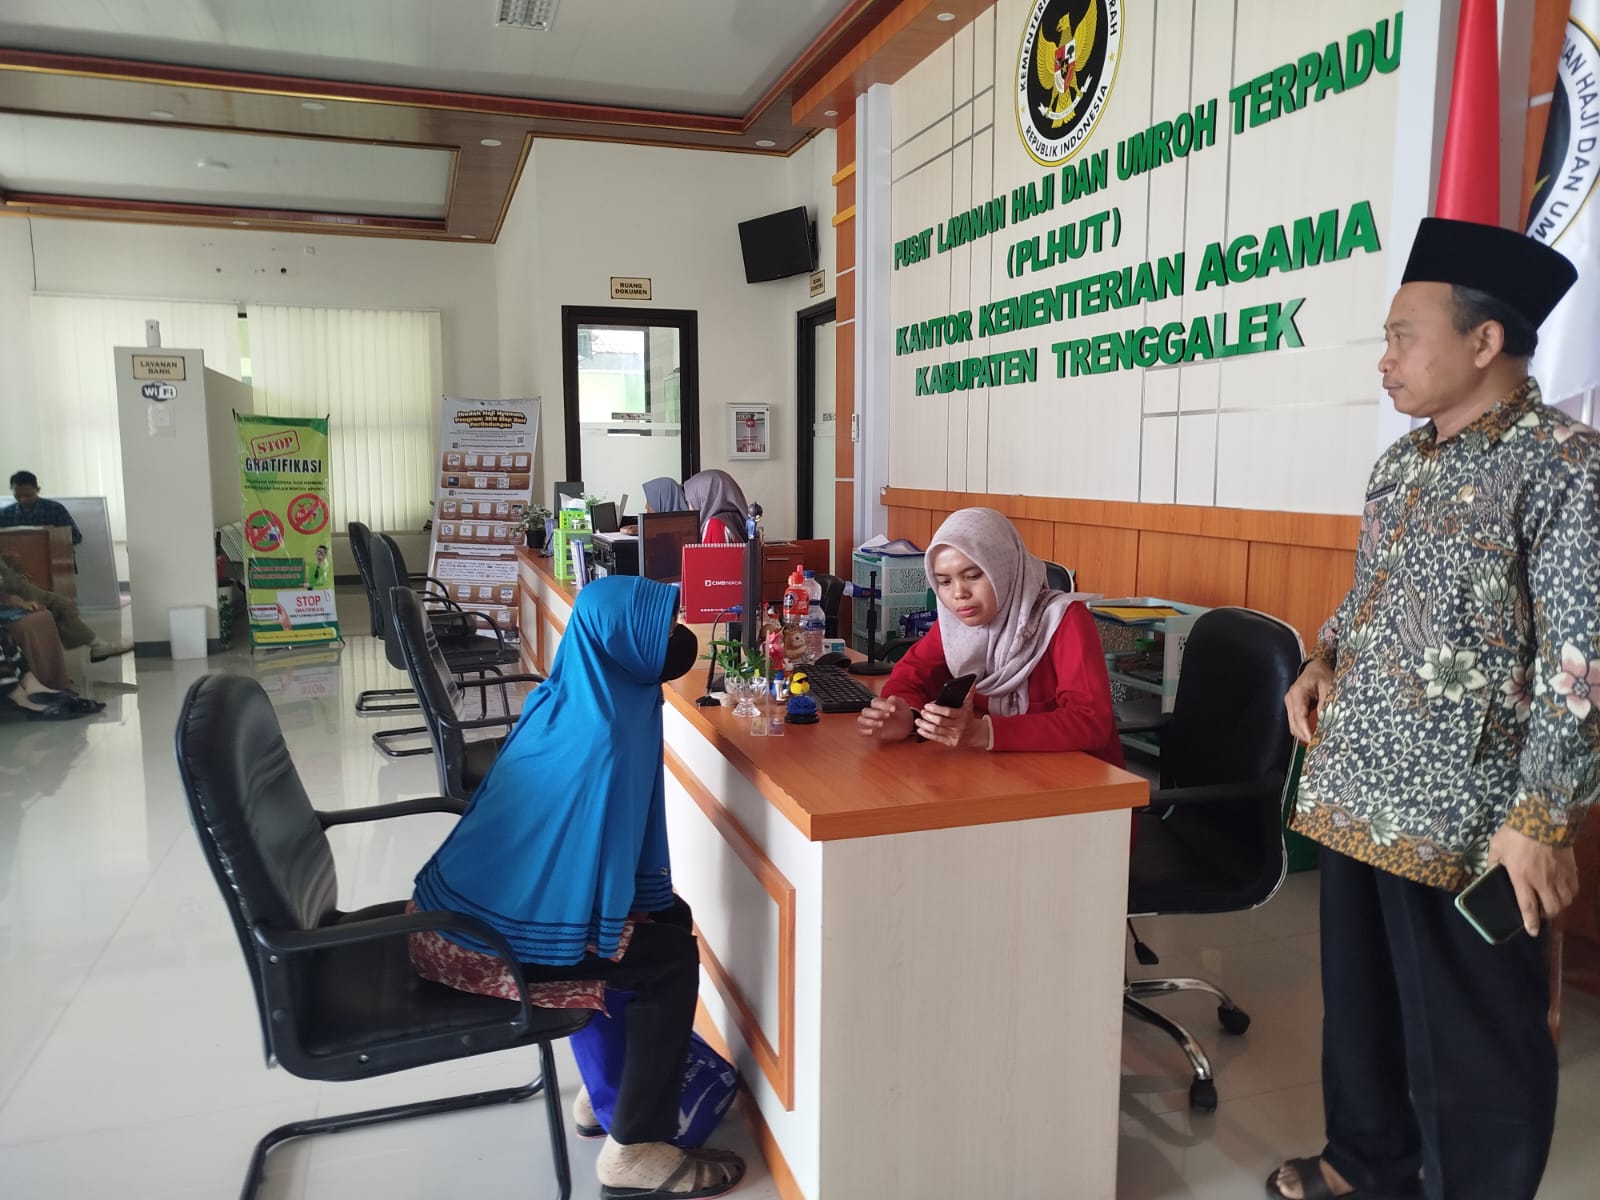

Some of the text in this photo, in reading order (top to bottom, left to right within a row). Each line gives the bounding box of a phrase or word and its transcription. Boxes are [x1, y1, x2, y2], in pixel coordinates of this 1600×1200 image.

[1025, 85, 1108, 158] REPUBLIK INDONESIA
[1576, 72, 1600, 129] HAJI
[894, 10, 1404, 271] PUSAT LAYANAN HAJI DAN UMROH TERPADU
[1563, 136, 1597, 191] DAN
[1006, 206, 1121, 279] (PLHUT)
[1531, 201, 1569, 240] UM
[896, 200, 1381, 356] KANTOR KEMENTERIAN AGAMA
[915, 297, 1306, 396] KABUPATEN TRENGGALEK
[245, 457, 322, 473] GRATIFIKASI
[257, 436, 293, 454] STOP
[296, 595, 321, 607] STOP
